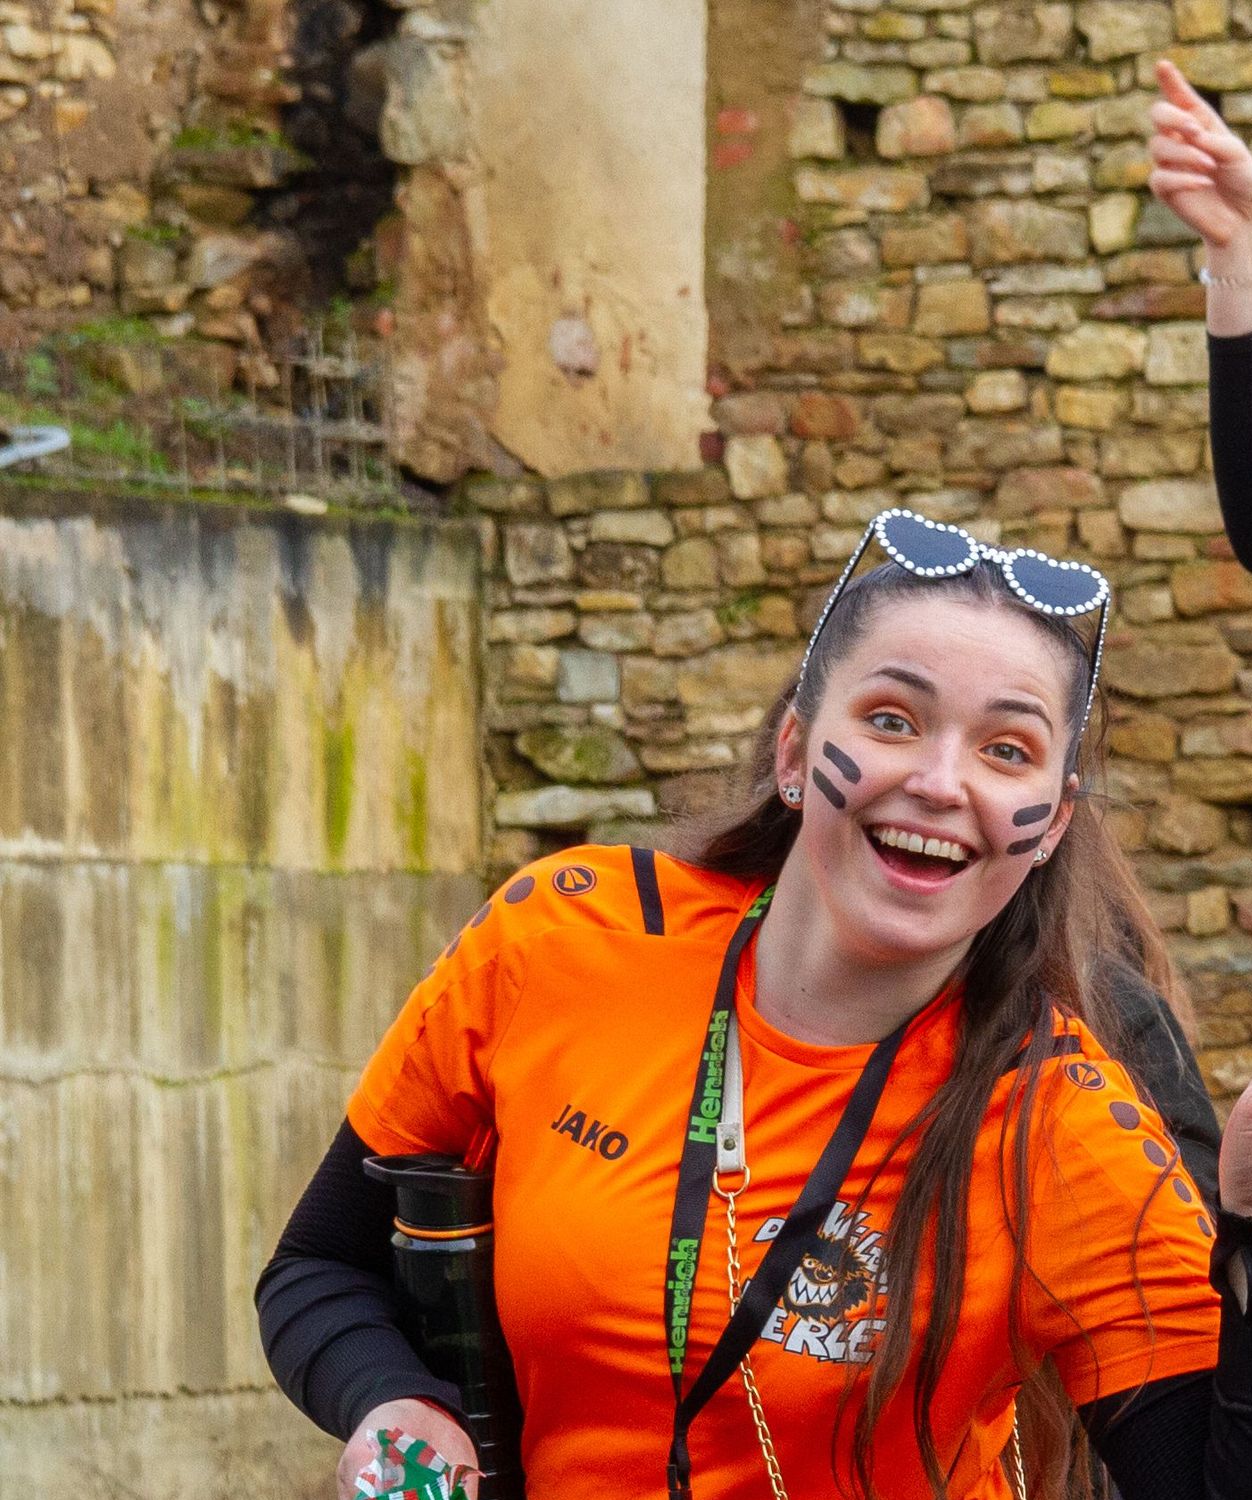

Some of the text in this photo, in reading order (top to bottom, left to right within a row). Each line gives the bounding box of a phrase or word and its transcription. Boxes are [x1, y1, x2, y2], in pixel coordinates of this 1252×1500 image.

[550, 1103, 630, 1161] JAKO
[688, 1010, 729, 1144] Henrich
[658, 1238, 699, 1374] Henrich
[741, 1278, 889, 1364] ERLE
